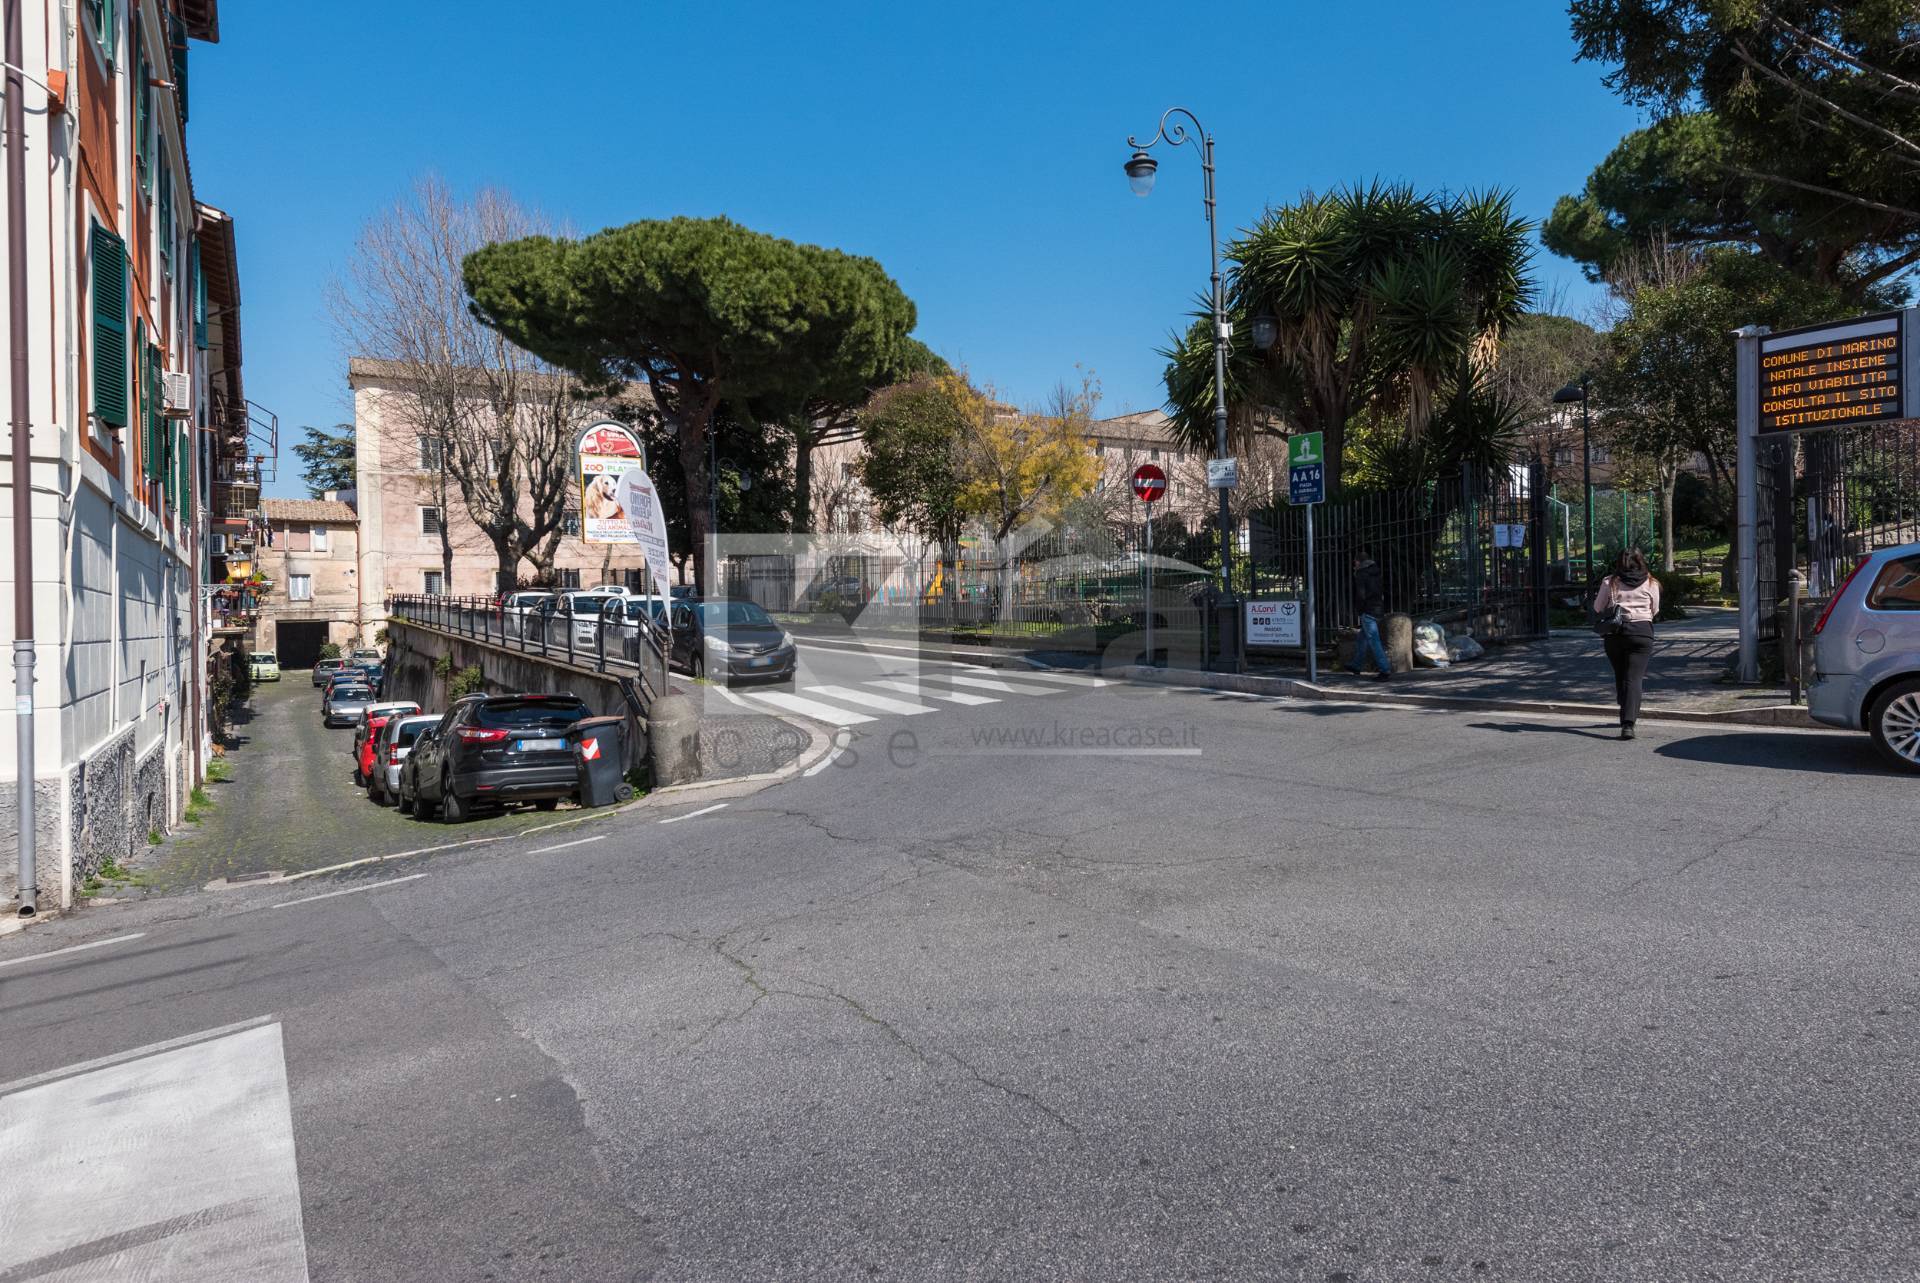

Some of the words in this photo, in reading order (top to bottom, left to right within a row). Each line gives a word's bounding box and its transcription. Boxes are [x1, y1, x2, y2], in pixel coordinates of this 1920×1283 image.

[1763, 351, 1809, 368] COMUNE
[1817, 347, 1833, 359] DI
[1842, 337, 1896, 355] MARINO
[1770, 365, 1817, 382] NATALE
[1827, 354, 1887, 373] INSIEME
[1771, 383, 1801, 397] INFO
[1808, 371, 1887, 391] VIABILITA
[1763, 395, 1826, 413] CONSULTA
[1835, 392, 1851, 403] IL
[1860, 386, 1896, 400] SITO
[1775, 403, 1883, 427] ISTITUZIONALE
[584, 463, 604, 472] ZOO
[1309, 468, 1321, 480] 16
